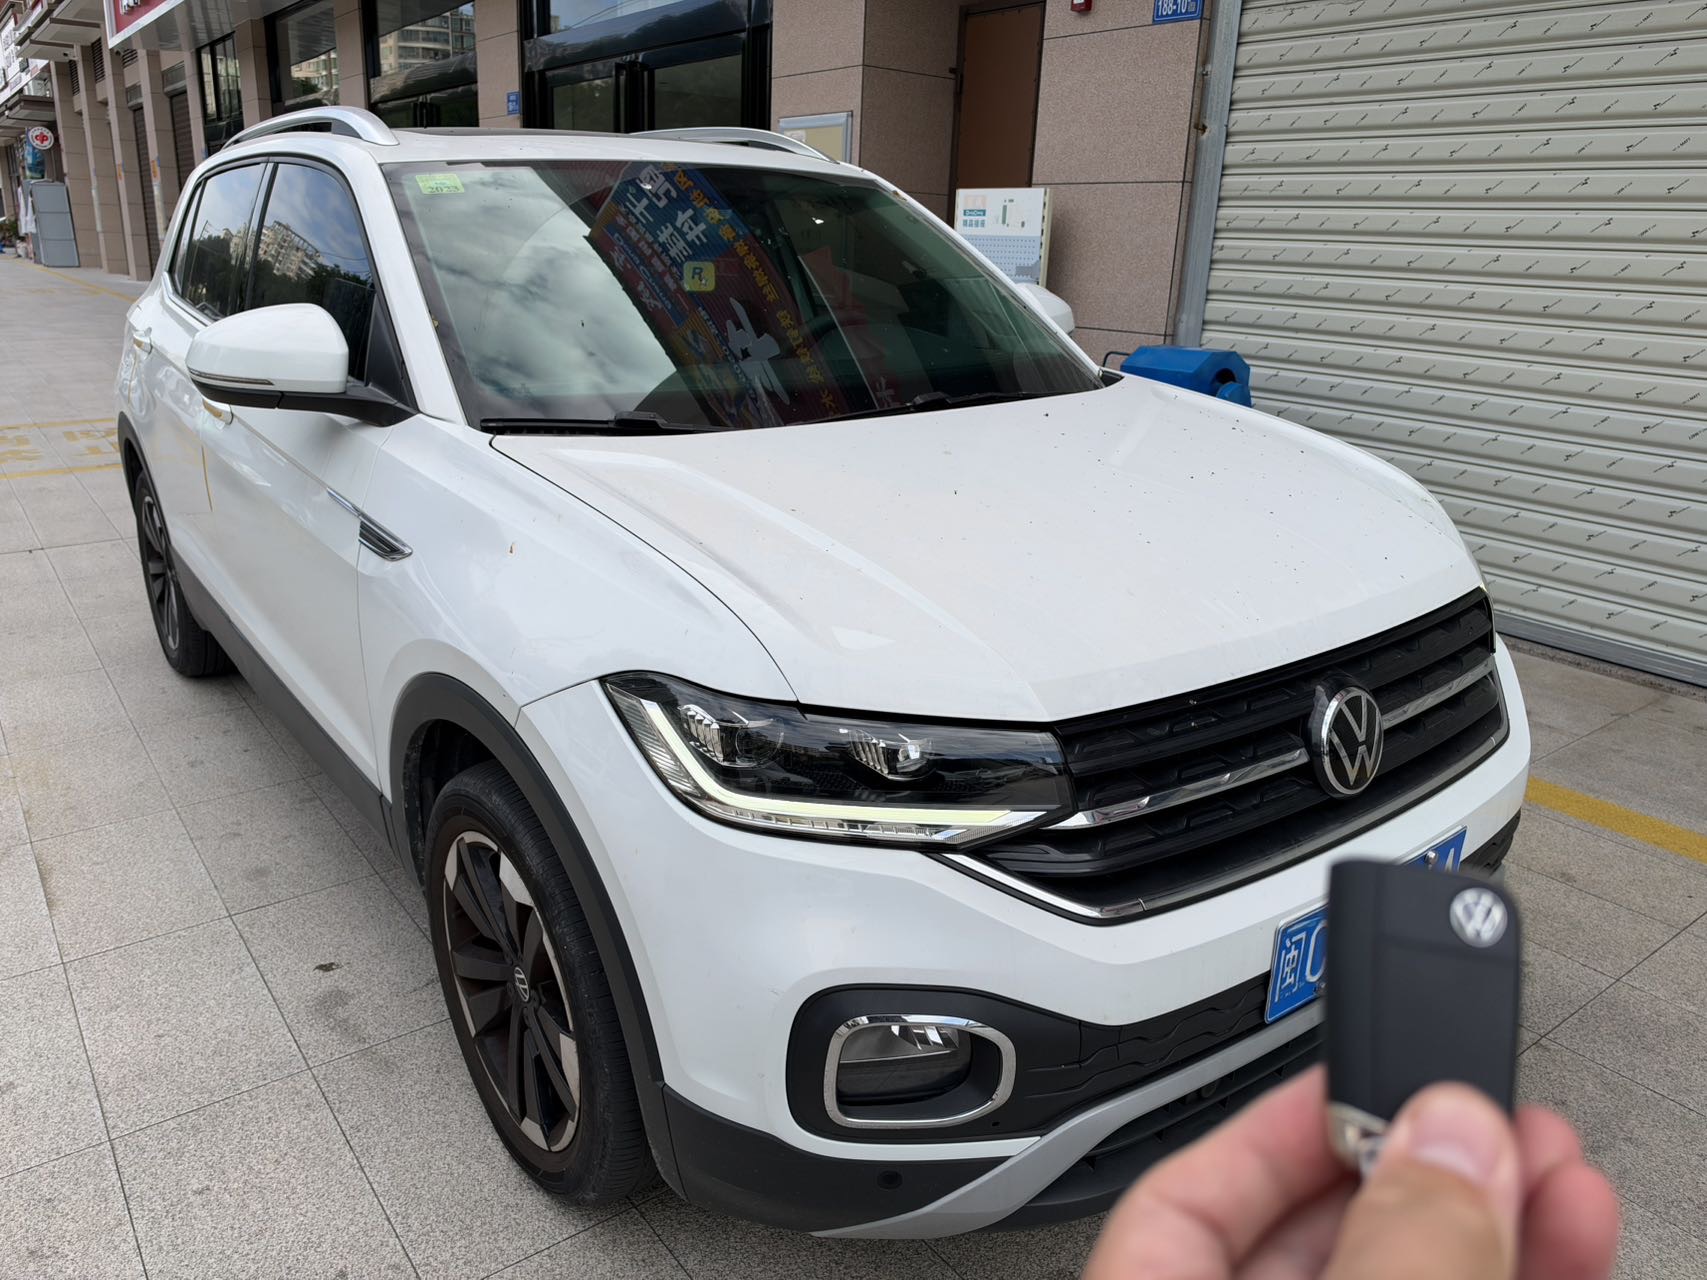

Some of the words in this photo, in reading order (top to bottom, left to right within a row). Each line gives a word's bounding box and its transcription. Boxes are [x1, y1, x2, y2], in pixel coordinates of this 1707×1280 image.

[1158, 0, 1188, 16] 188-10
[1327, 690, 1380, 787] VW
[1451, 889, 1507, 945] VW
